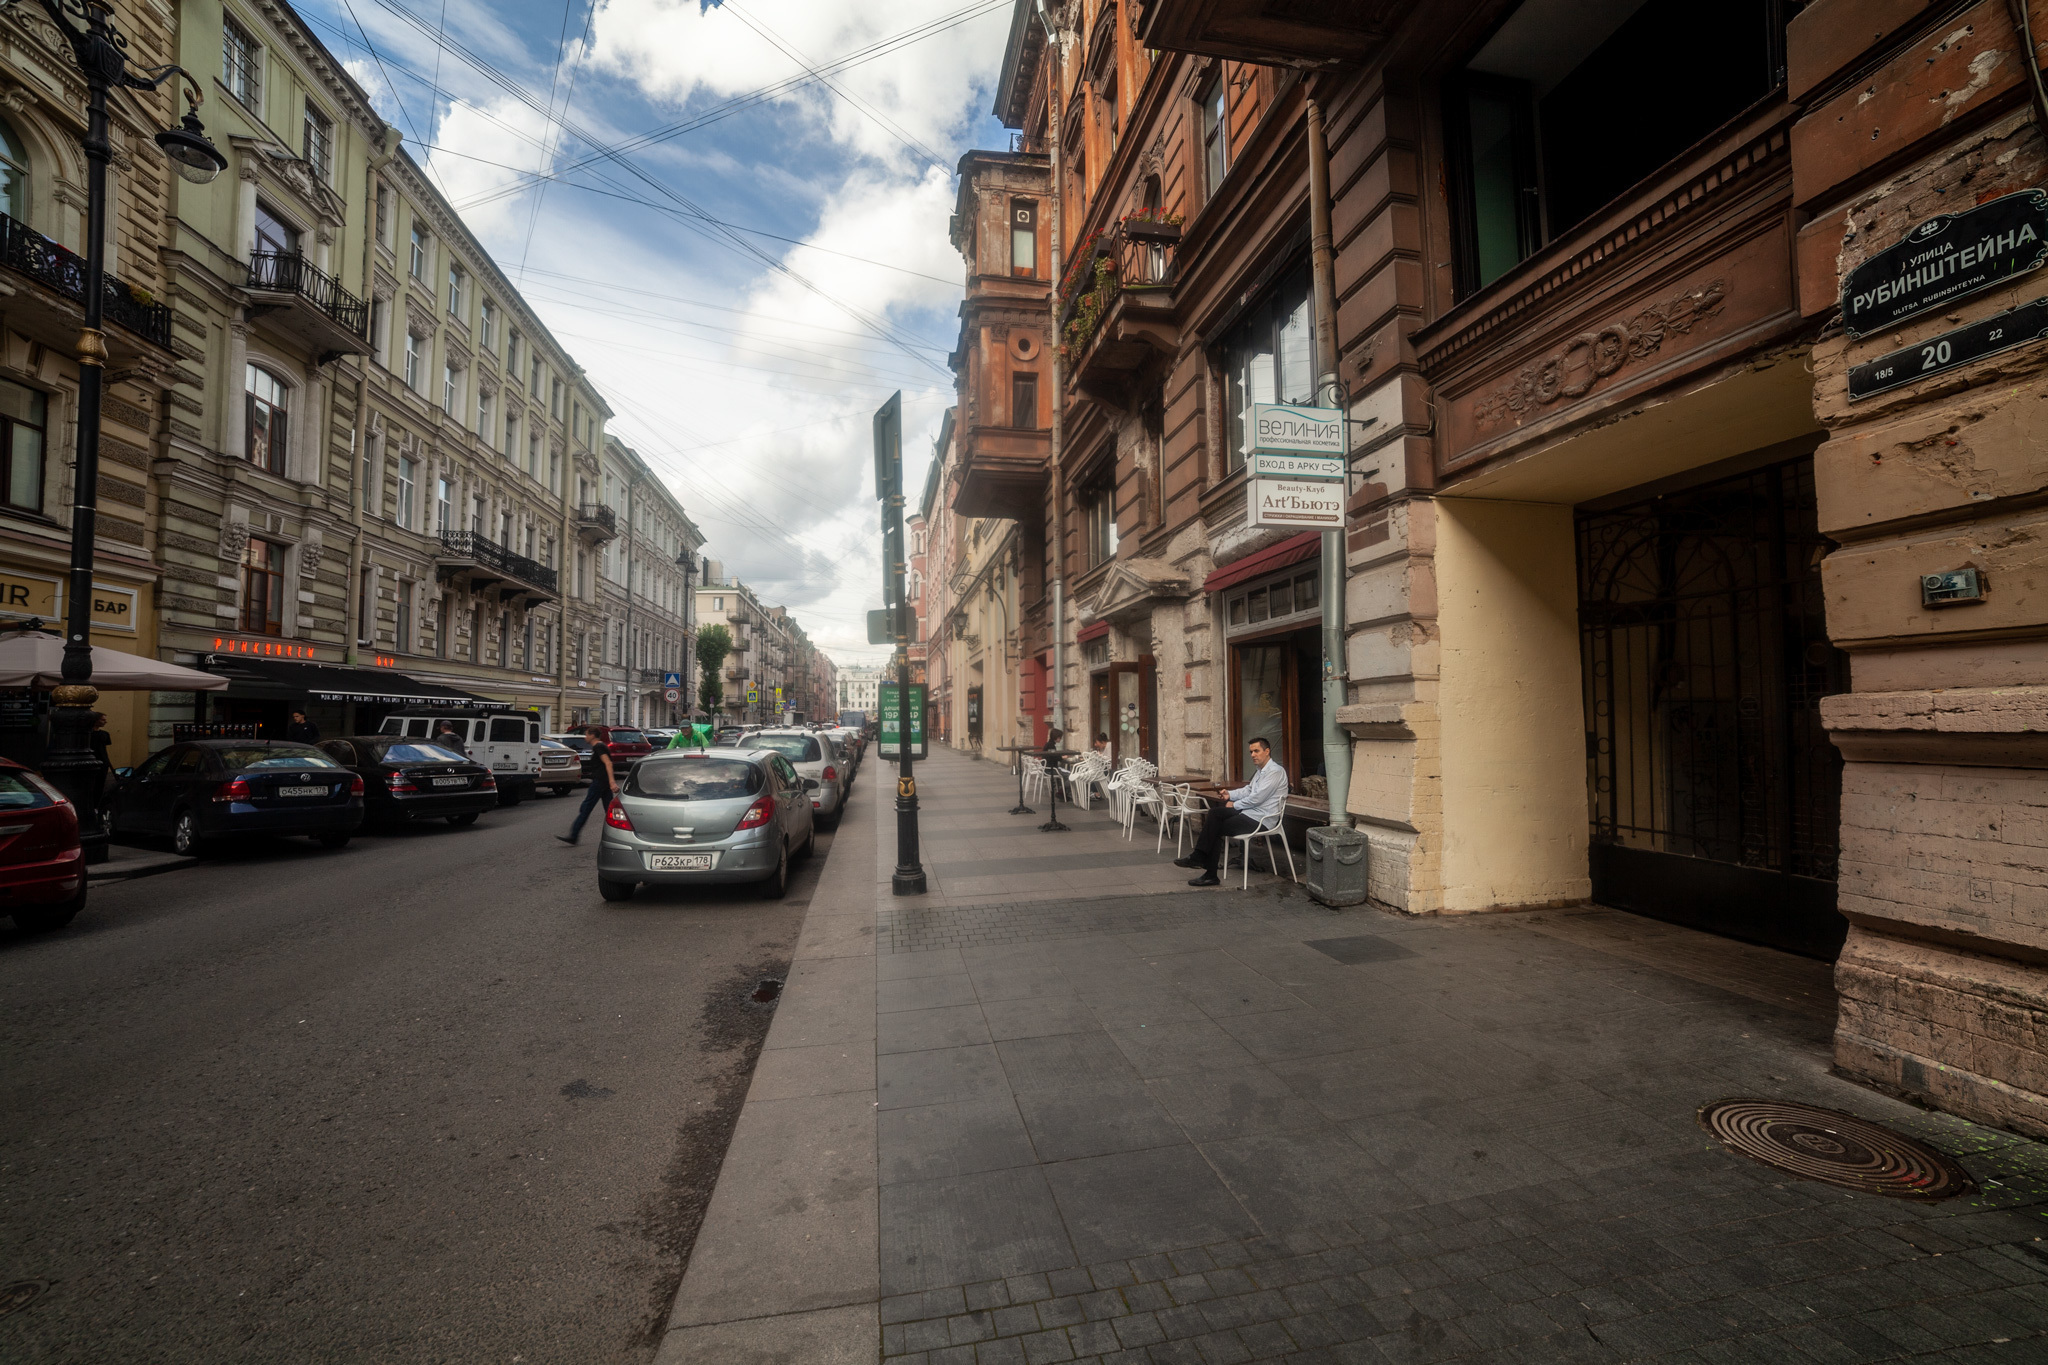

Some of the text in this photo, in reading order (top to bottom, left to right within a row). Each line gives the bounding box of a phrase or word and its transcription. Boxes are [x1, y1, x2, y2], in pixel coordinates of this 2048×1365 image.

[1910, 241, 1954, 268] УЛИЦА
[1853, 222, 2038, 315] РУБИНШТЕЙНА
[1892, 274, 1986, 316] ULITSA RUBINSHTEYNA
[1874, 328, 2003, 380] 18/5 20 22
[1260, 436, 1311, 445] профессиональная
[1259, 459, 1320, 470] ВХОД В АРКУ
[1277, 484, 1325, 494] Beauty-Клуб
[94, 599, 127, 614] БАР
[694, 856, 708, 864] 178
